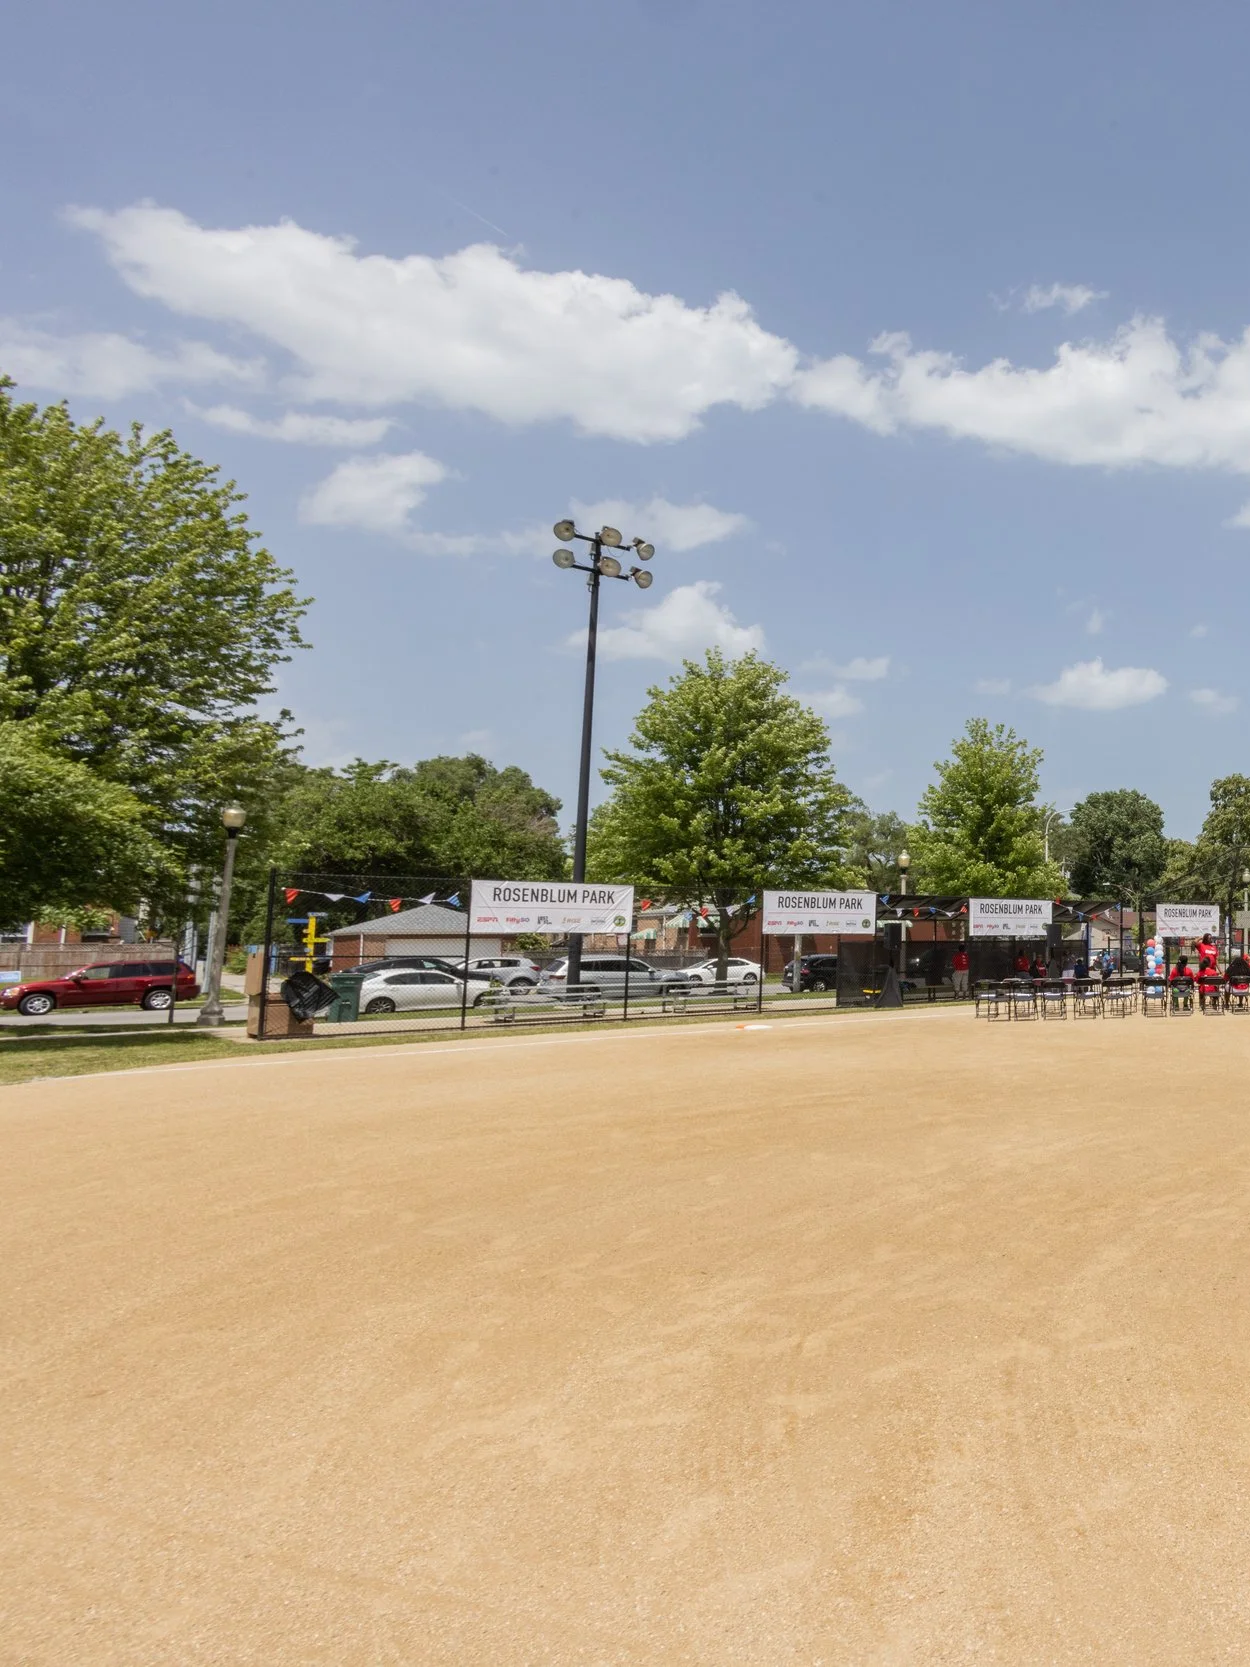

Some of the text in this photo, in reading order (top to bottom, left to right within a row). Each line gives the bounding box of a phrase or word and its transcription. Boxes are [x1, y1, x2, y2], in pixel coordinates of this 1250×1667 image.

[493, 887, 615, 904] ROSENBLUM PARK
[778, 896, 863, 909] ROSENBLUM PARK
[980, 903, 1043, 914] ROSENBLUM PARK
[1164, 908, 1212, 918] ROSENBLUM PARK
